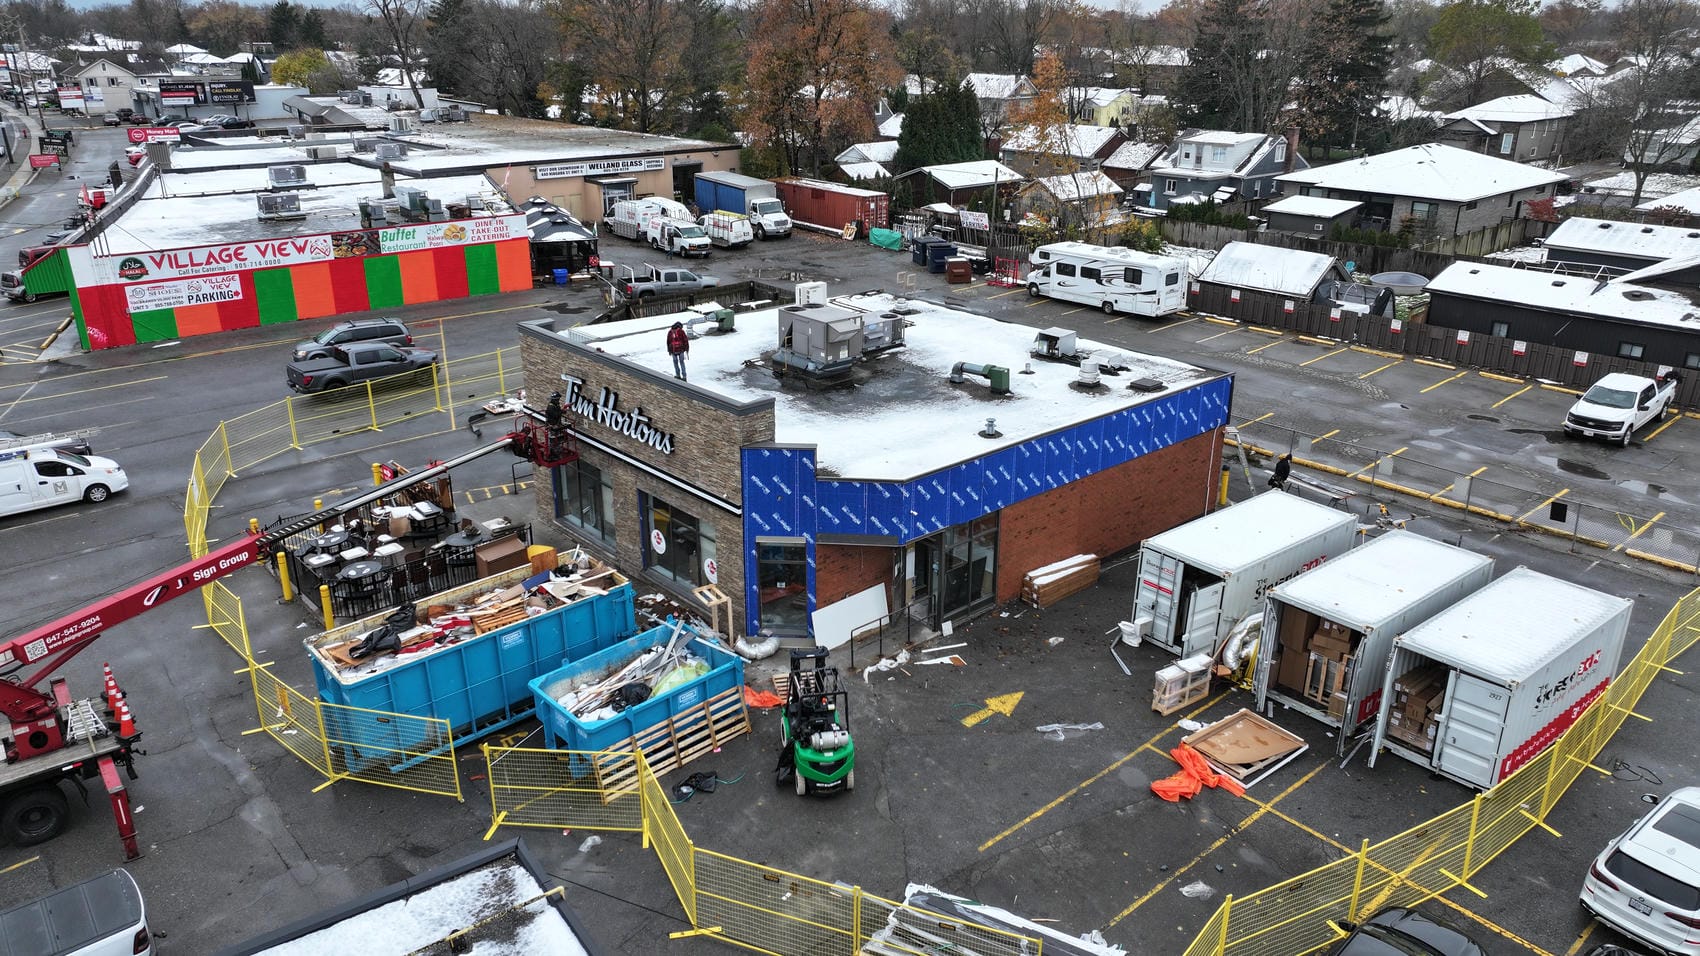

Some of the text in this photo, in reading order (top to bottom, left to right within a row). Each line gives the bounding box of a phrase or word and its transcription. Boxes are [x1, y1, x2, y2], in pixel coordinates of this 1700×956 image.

[588, 160, 643, 170] WELLAND GLASS
[475, 220, 493, 228] DINE
[381, 228, 417, 243] Buffet
[471, 232, 510, 241] CATERING
[381, 240, 426, 252] Restaurant
[148, 240, 309, 271] VILLAGE VIEW
[202, 265, 226, 274] Catering
[202, 275, 238, 284] VILLAGE
[210, 282, 231, 290] VIEW
[187, 289, 234, 305] PARKING
[560, 373, 675, 455] Tim Hortons
[192, 565, 217, 582] Sign
[219, 551, 249, 570] Group
[46, 615, 101, 644] 647-547-9204
